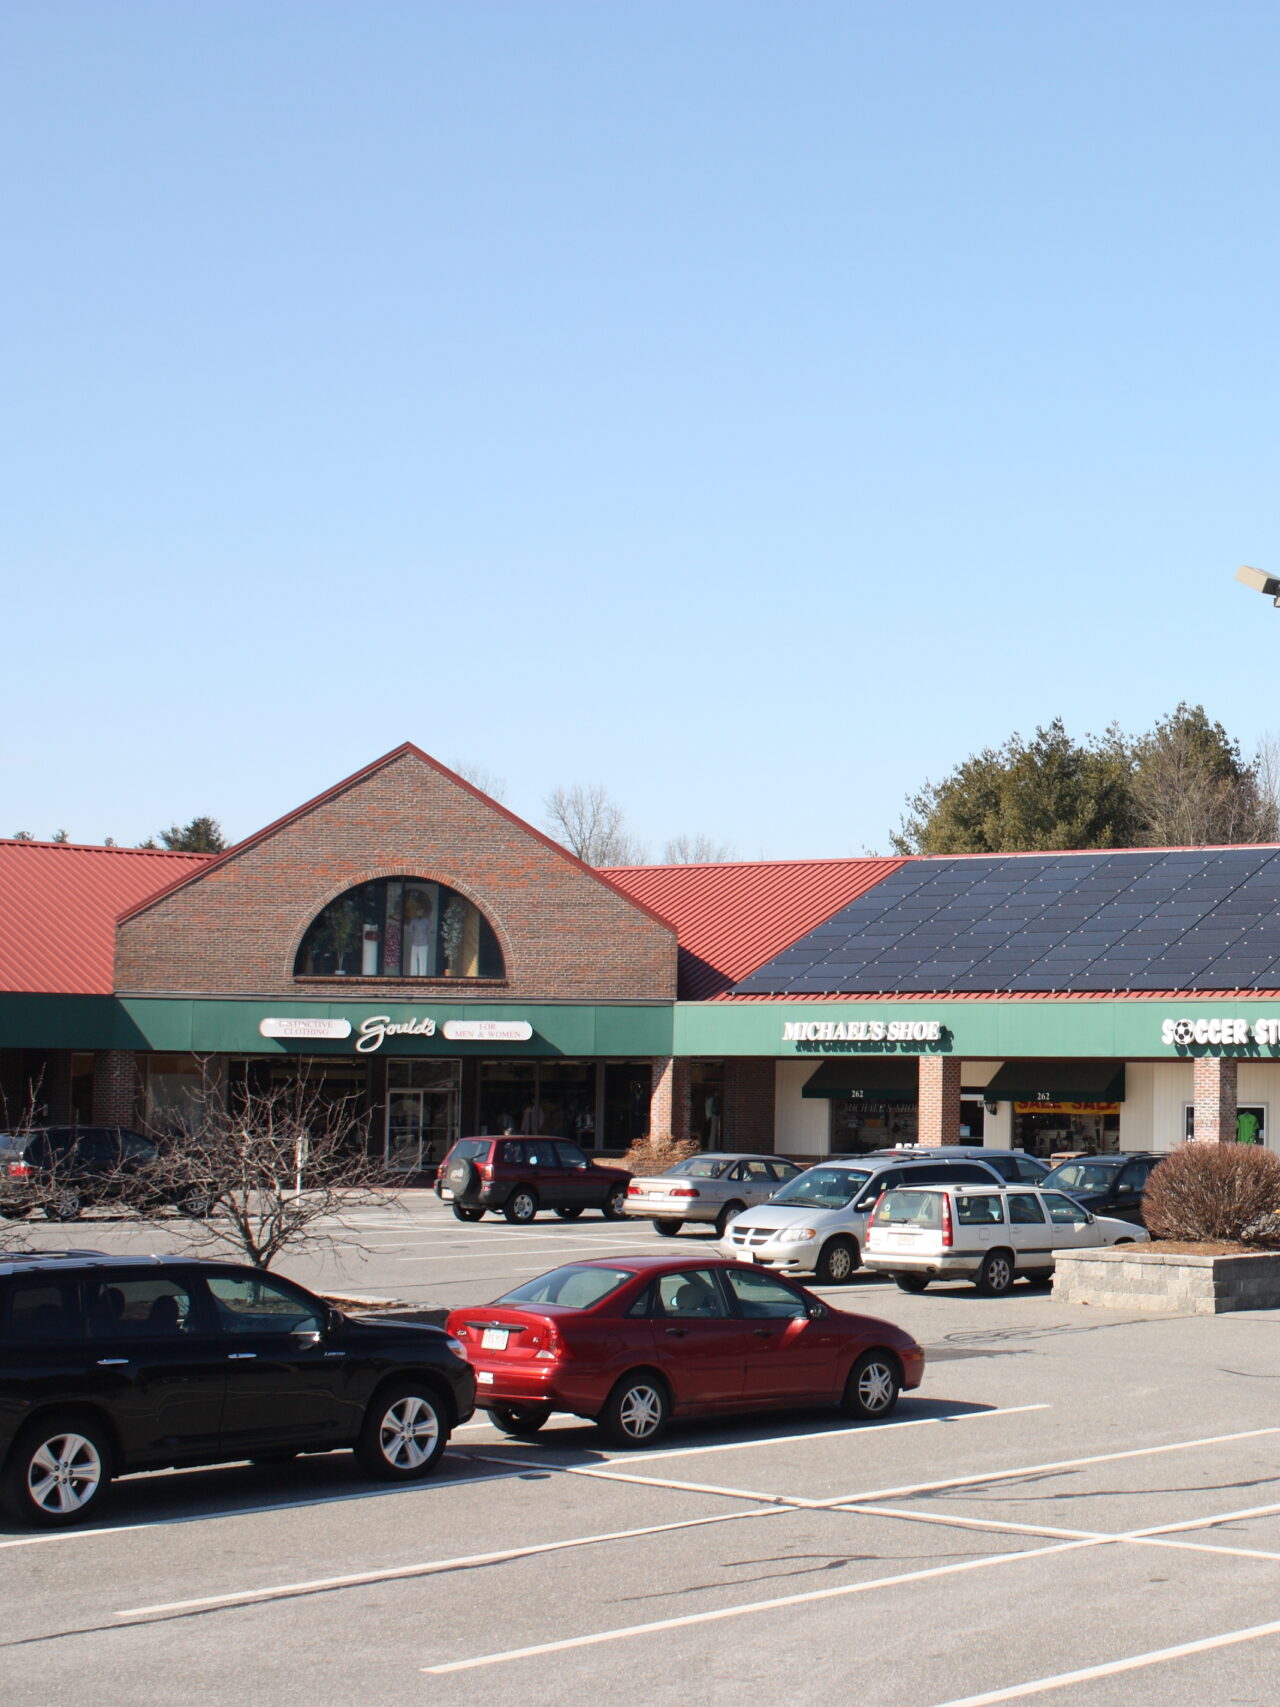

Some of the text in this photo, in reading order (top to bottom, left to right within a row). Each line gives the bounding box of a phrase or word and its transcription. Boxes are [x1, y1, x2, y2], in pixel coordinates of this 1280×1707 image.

[279, 1020, 333, 1028] STINCTIVE
[283, 1028, 329, 1036] CLOTHING
[356, 1015, 436, 1053] Gould's
[782, 1021, 942, 1041] MICHAEL'S SHOE
[1161, 1018, 1249, 1045] SOCCER
[851, 1090, 864, 1098] 262
[1037, 1092, 1050, 1101] 262
